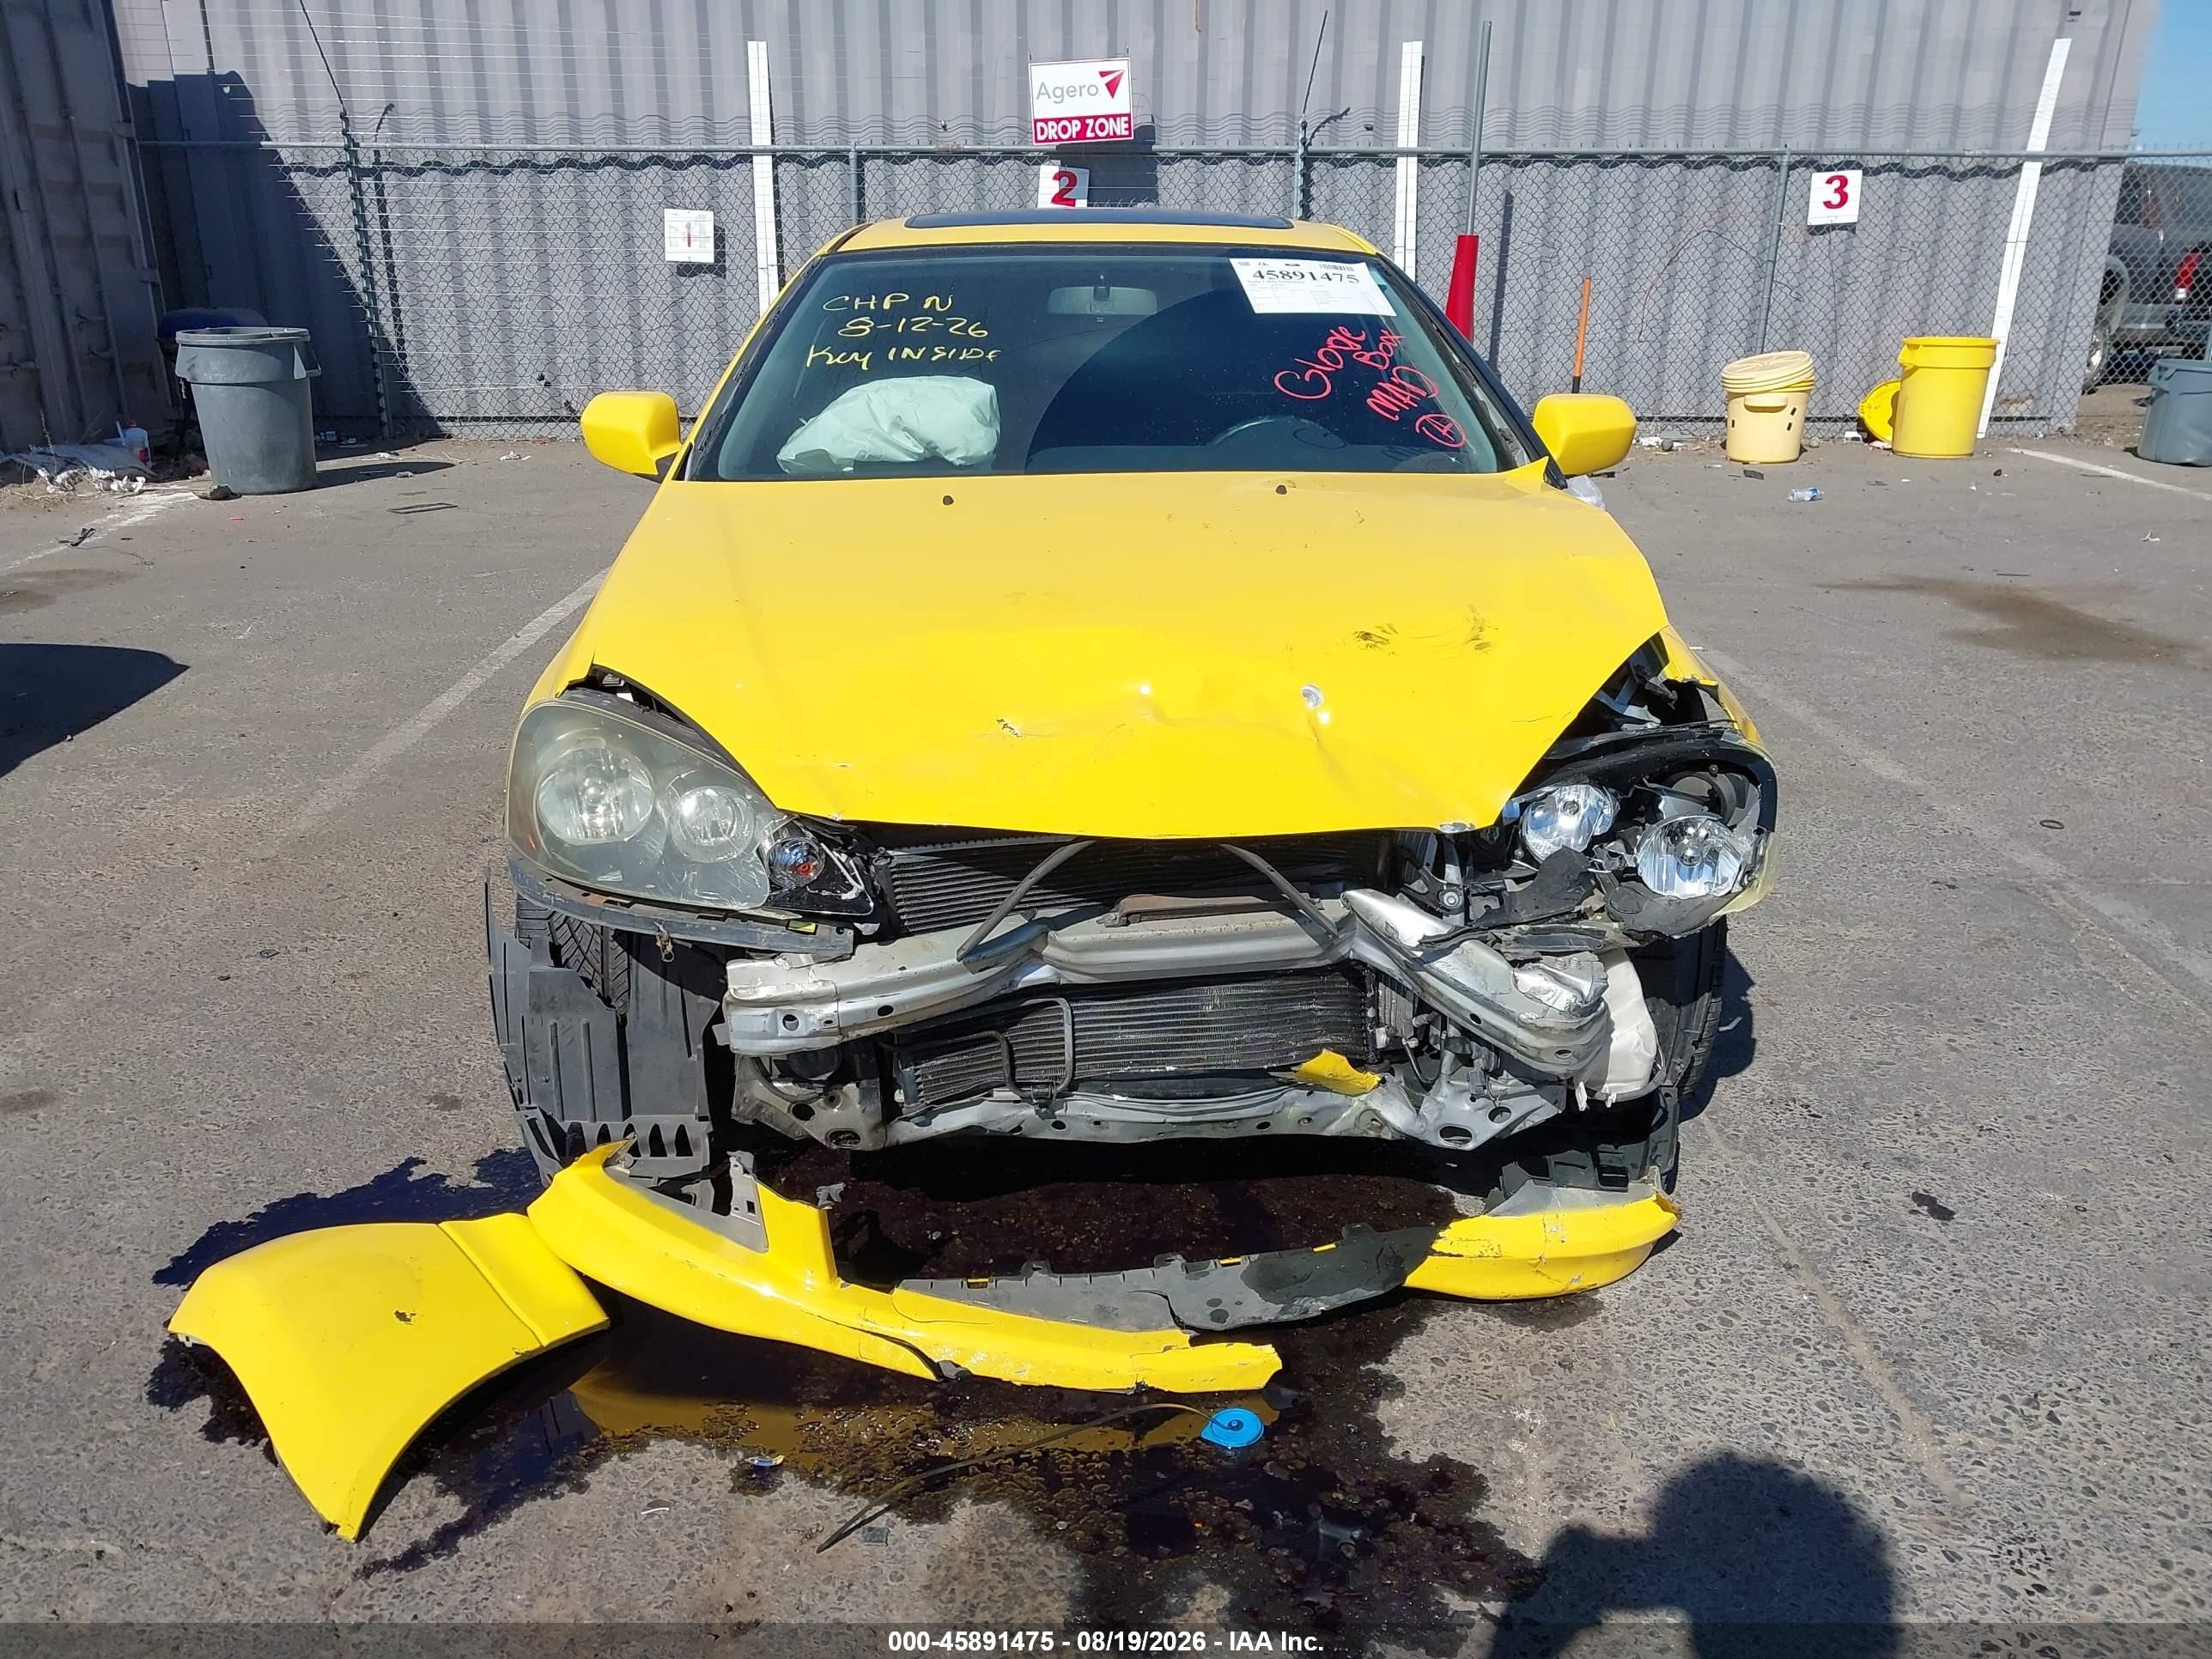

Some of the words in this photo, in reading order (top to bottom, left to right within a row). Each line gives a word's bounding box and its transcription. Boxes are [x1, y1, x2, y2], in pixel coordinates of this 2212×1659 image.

[1036, 82, 1099, 105] Agero
[1036, 118, 1082, 141] DROP
[1085, 116, 1130, 138] ZONE
[1050, 169, 1079, 207] 2
[1822, 174, 1849, 210] 3
[1252, 269, 1361, 284] 45891475
[823, 293, 910, 311] CHP
[837, 316, 989, 337] 8-12-26
